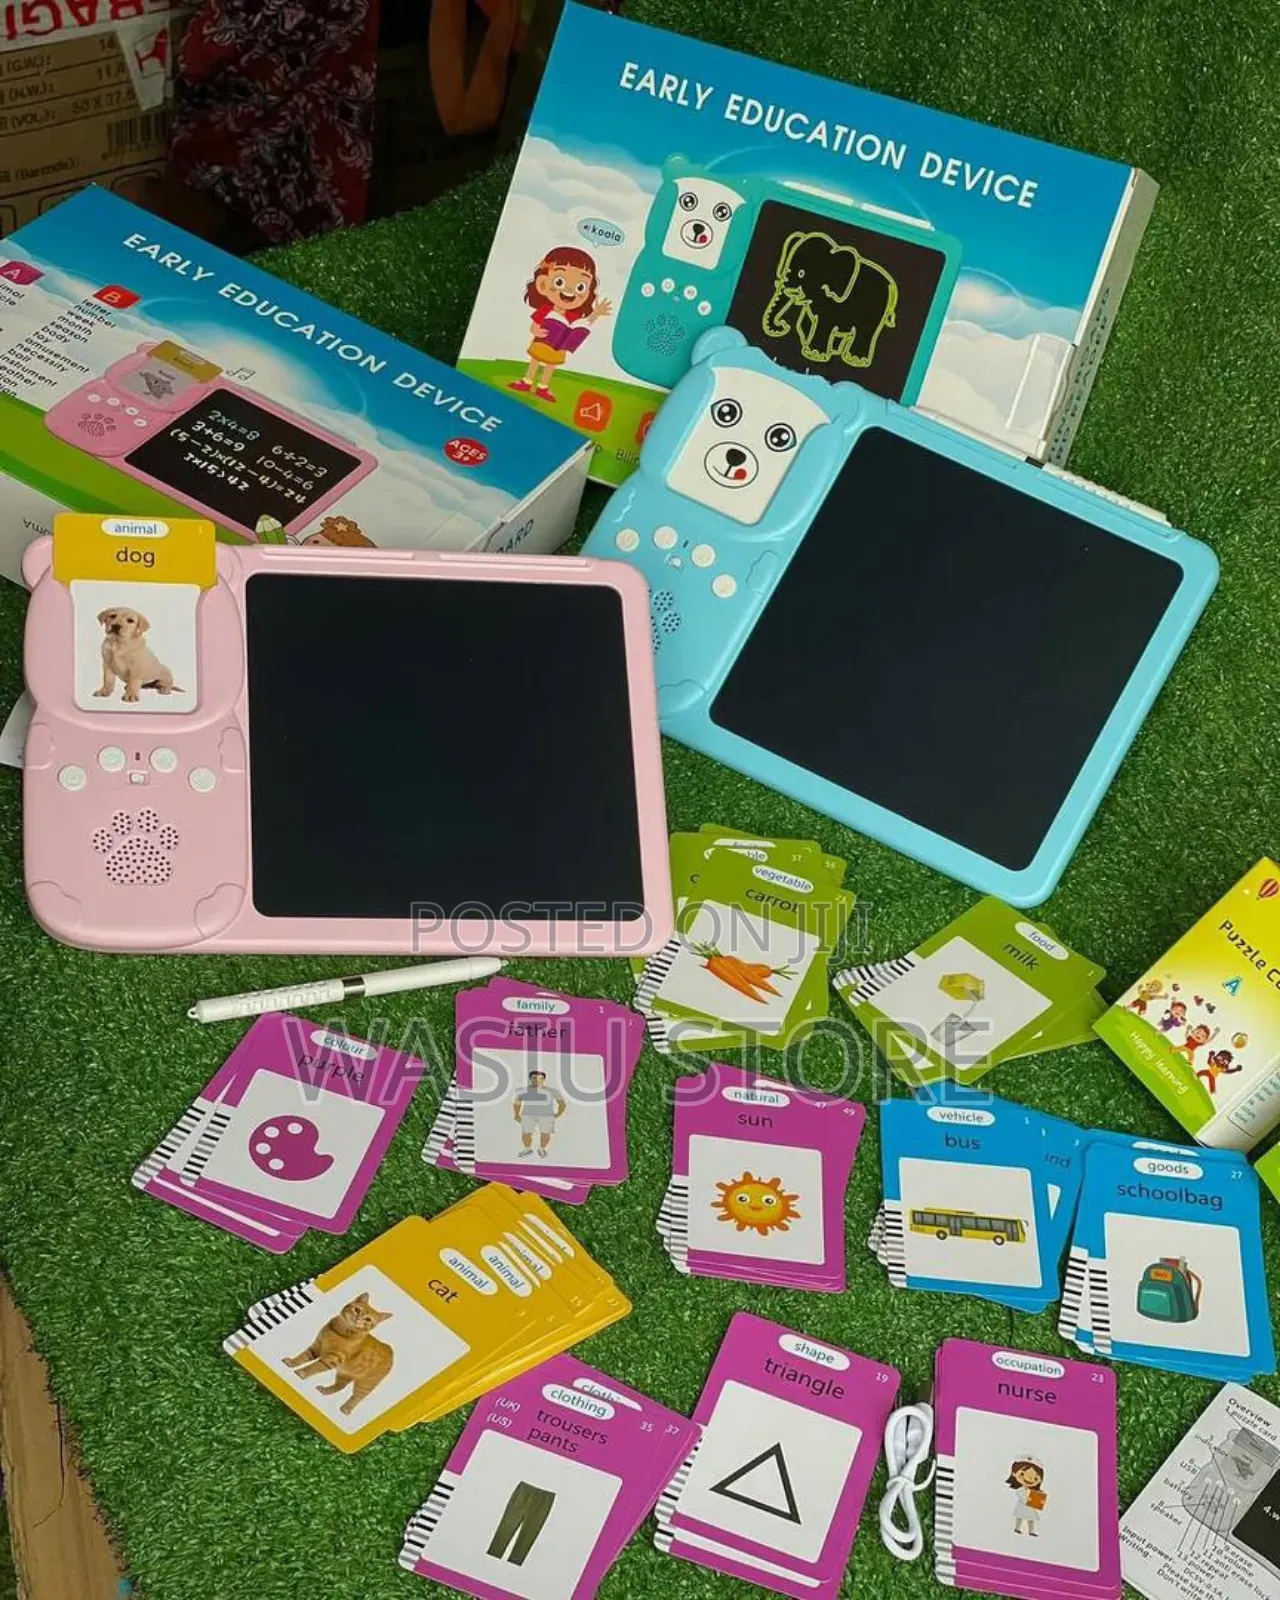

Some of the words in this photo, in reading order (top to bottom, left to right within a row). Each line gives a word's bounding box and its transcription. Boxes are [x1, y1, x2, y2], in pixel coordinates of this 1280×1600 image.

[619, 62, 713, 110] EARLY
[724, 93, 906, 169] EDUCATION
[919, 151, 1039, 209] DEVICE
[2, 269, 21, 279] A
[82, 298, 112, 316] letter
[102, 291, 122, 303] B
[58, 315, 93, 336] month
[67, 310, 96, 328] week
[74, 305, 117, 329] number
[32, 331, 52, 344] toy
[41, 326, 71, 344] body
[50, 321, 89, 344] season
[122, 233, 215, 282] EARLY
[218, 282, 387, 374] EDUCATION
[393, 372, 503, 432] DEVICE
[16, 343, 70, 373] necessity
[25, 338, 90, 374] amusement
[448, 439, 487, 461] AGES
[115, 523, 157, 535] animal
[116, 547, 155, 567] dog
[755, 867, 812, 892] vegetable
[745, 888, 802, 914] carrot
[1028, 931, 1055, 952] food
[1219, 919, 1267, 970] Puzzle
[1004, 943, 1040, 971] milk
[516, 999, 556, 1013] family
[298, 1052, 364, 1083] purple
[1129, 1030, 1155, 1062] Happy
[1154, 1057, 1188, 1095] learning
[734, 1090, 779, 1104] natural
[737, 1113, 773, 1128] sun
[939, 1110, 984, 1124] vehicle
[944, 1132, 981, 1150] bus
[1147, 1161, 1189, 1176] goods
[1117, 1181, 1223, 1211] schoolbag
[448, 1256, 489, 1289] animal
[488, 1254, 525, 1290] animal
[427, 1278, 459, 1304] cat
[794, 1342, 835, 1364] shape
[996, 1356, 1062, 1376] occupation
[764, 1357, 845, 1400] triangle
[876, 1372, 889, 1383] 19
[550, 1388, 607, 1417] clothing
[998, 1382, 1057, 1404] nurse
[1228, 1398, 1271, 1427] Overview
[537, 1409, 609, 1445] trousers
[665, 1424, 680, 1436] 37
[527, 1426, 579, 1453] pants
[1150, 1503, 1182, 1526] speaker
[1122, 1525, 1147, 1545] Input
[1162, 1562, 1187, 1586] Please
[1189, 1581, 1206, 1594] use
